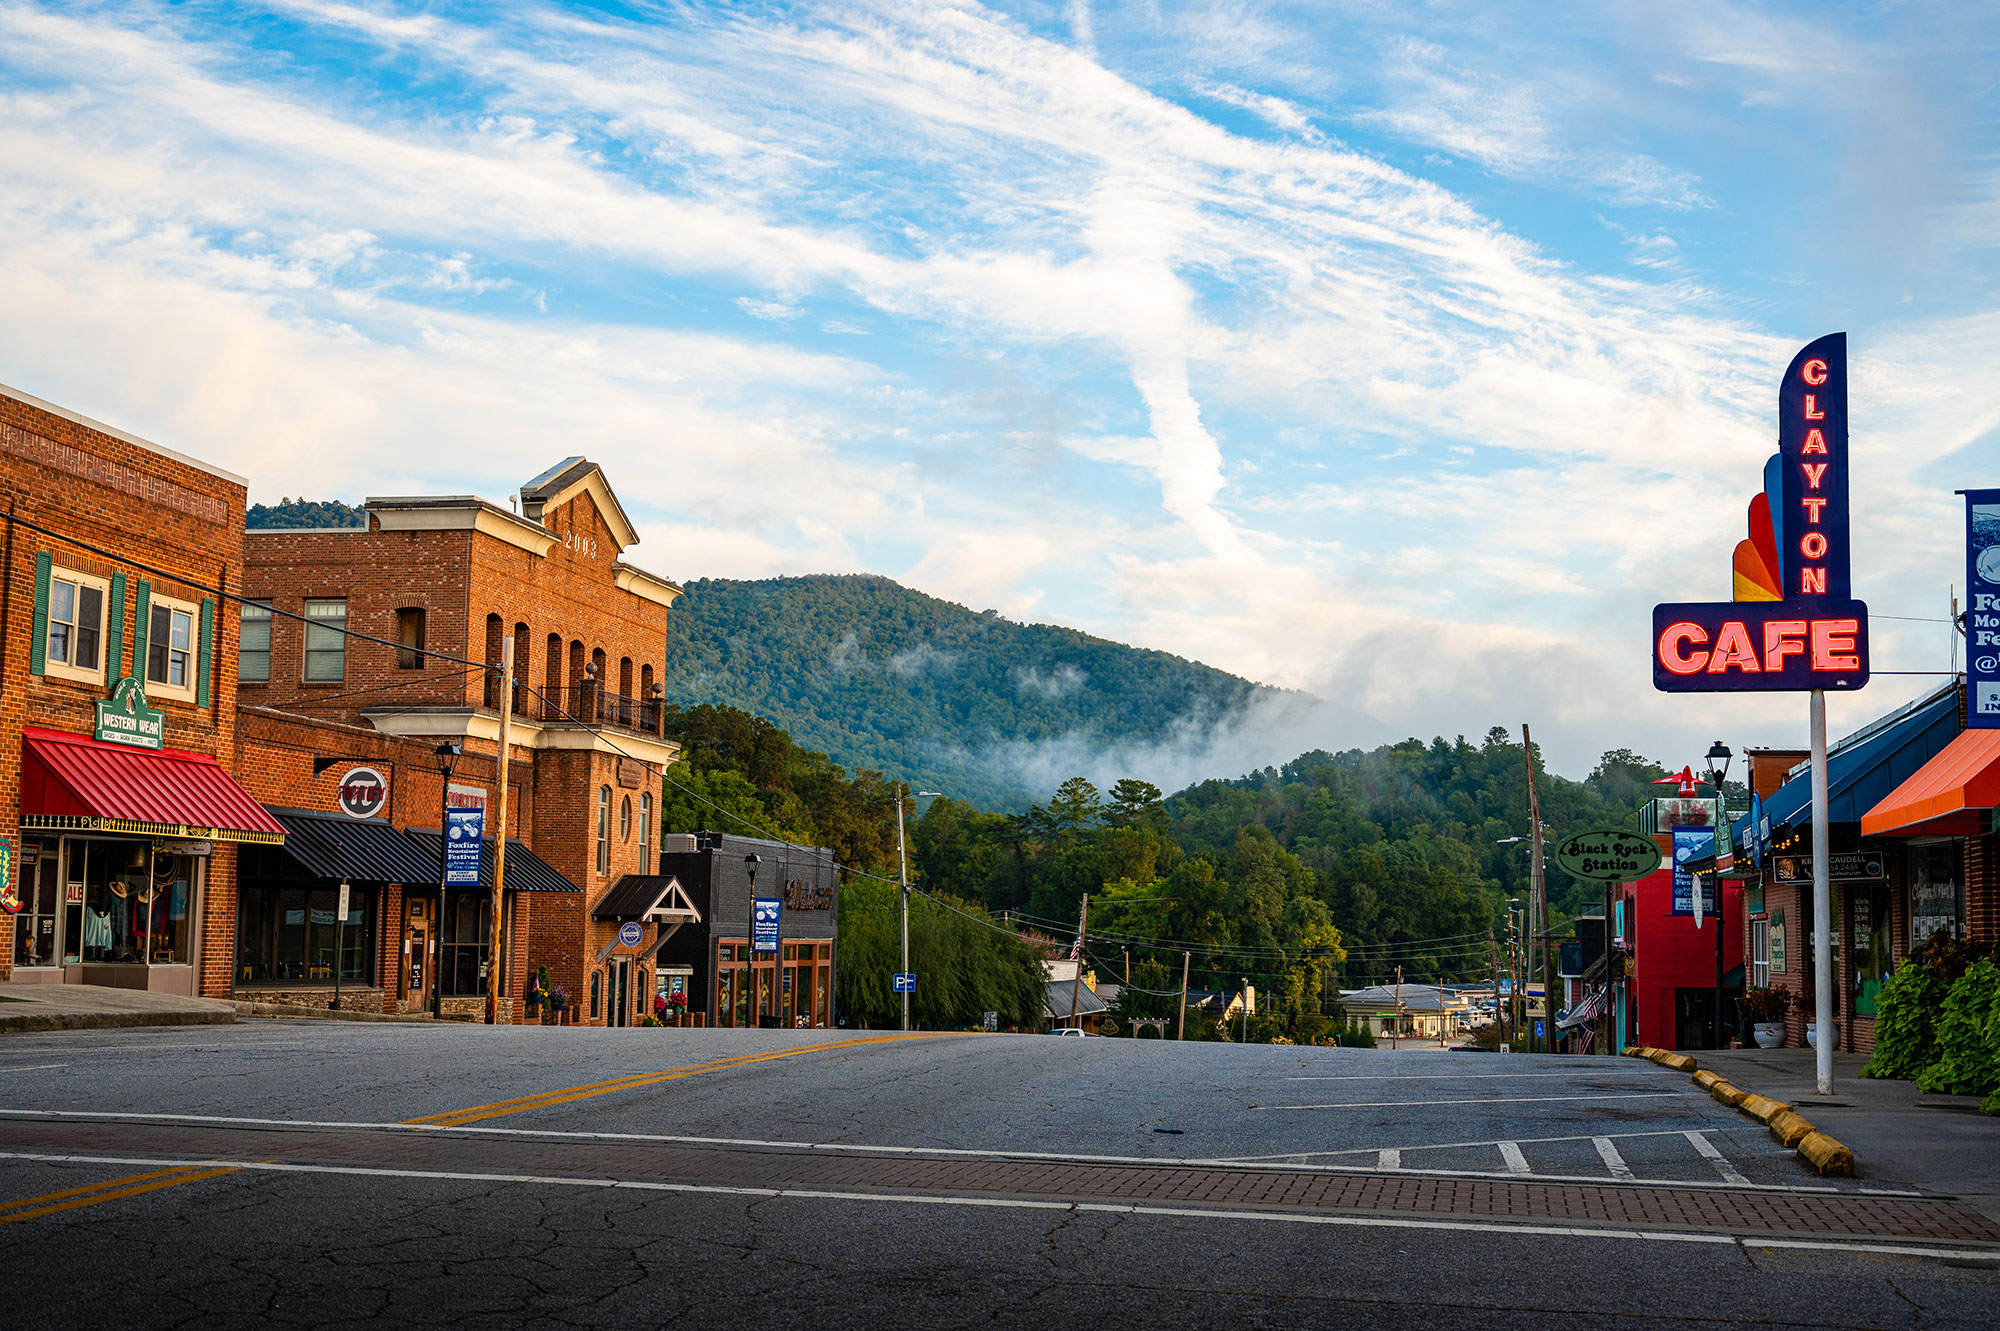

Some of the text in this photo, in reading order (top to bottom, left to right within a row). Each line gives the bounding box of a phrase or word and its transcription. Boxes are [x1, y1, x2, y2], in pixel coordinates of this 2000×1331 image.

[1801, 358, 1828, 594] CLAYTON
[566, 530, 597, 559] 2003
[1658, 618, 1861, 676] CAFE
[103, 713, 159, 735] WESTERN WEAR
[103, 731, 115, 739] SHOES
[338, 785, 386, 801] FORTIFY
[447, 791, 487, 811] FORTIFY
[448, 841, 480, 849] Foxfire
[1568, 842, 1648, 858] Black Rock
[1581, 857, 1639, 873] Station
[1829, 855, 1867, 864] CAUDELL
[67, 885, 82, 901] ALE
